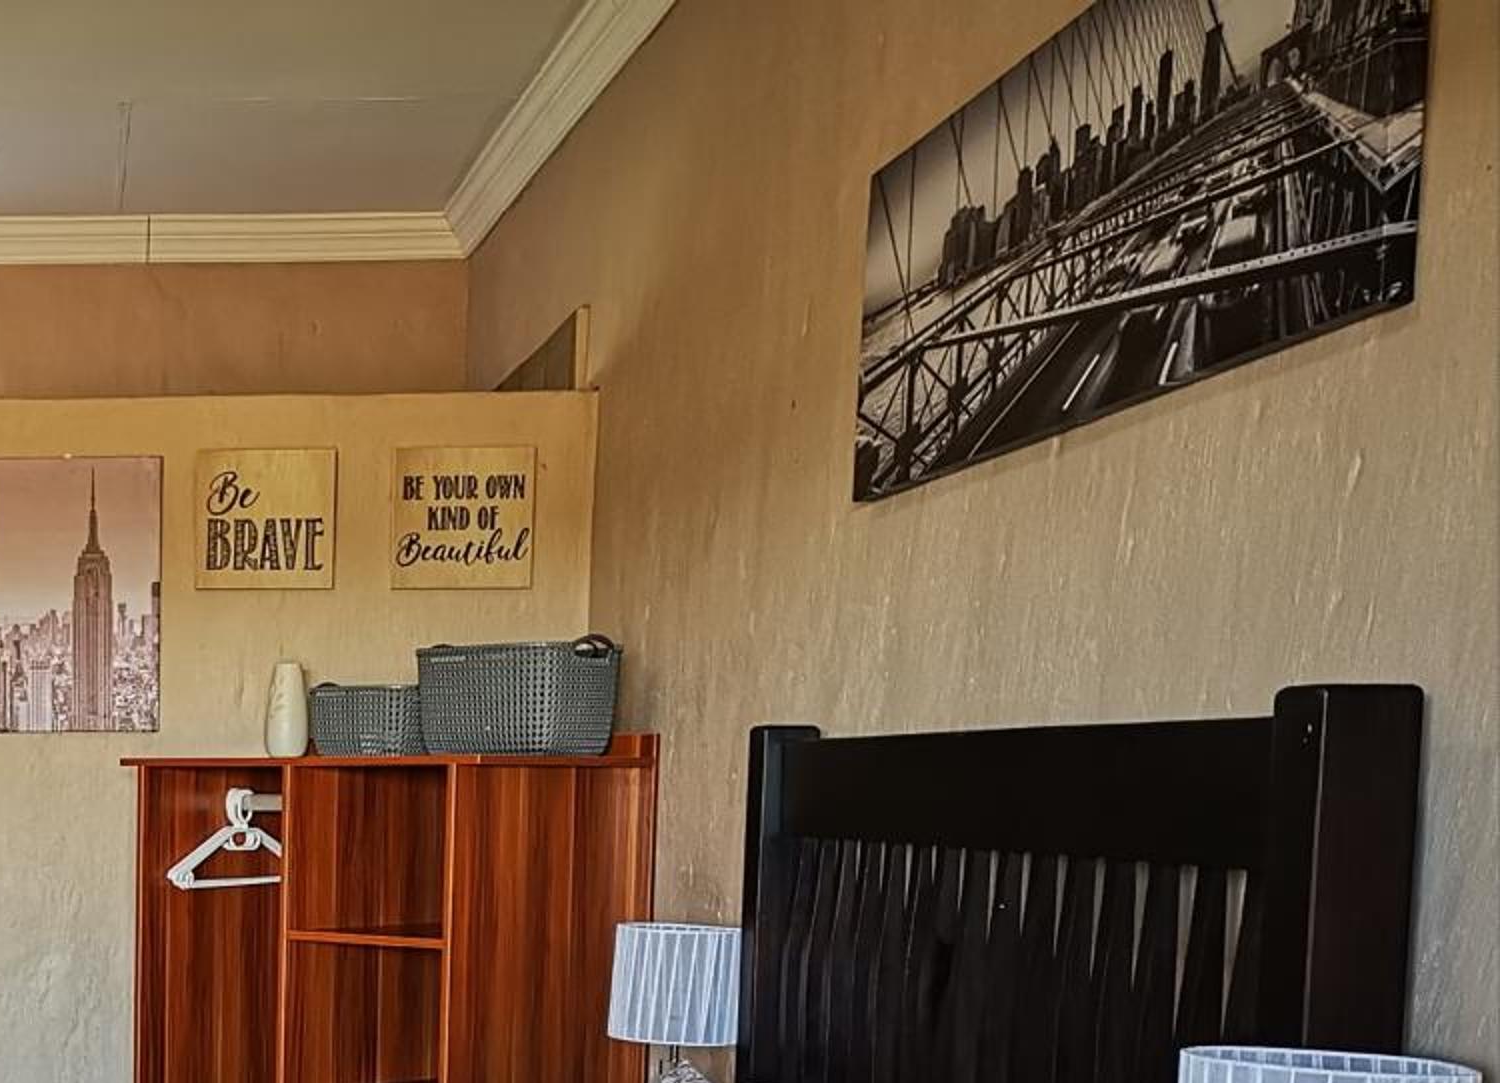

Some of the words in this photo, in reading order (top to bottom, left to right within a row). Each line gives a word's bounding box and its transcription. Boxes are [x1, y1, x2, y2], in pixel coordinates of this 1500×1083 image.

[206, 470, 260, 516] Be
[402, 475, 424, 500] BE
[432, 474, 478, 499] YOUR
[485, 474, 525, 499] OWN
[427, 506, 470, 530] KIND
[477, 505, 500, 530] OF
[206, 517, 324, 571] BRAVE
[395, 527, 530, 568] Beautiful
